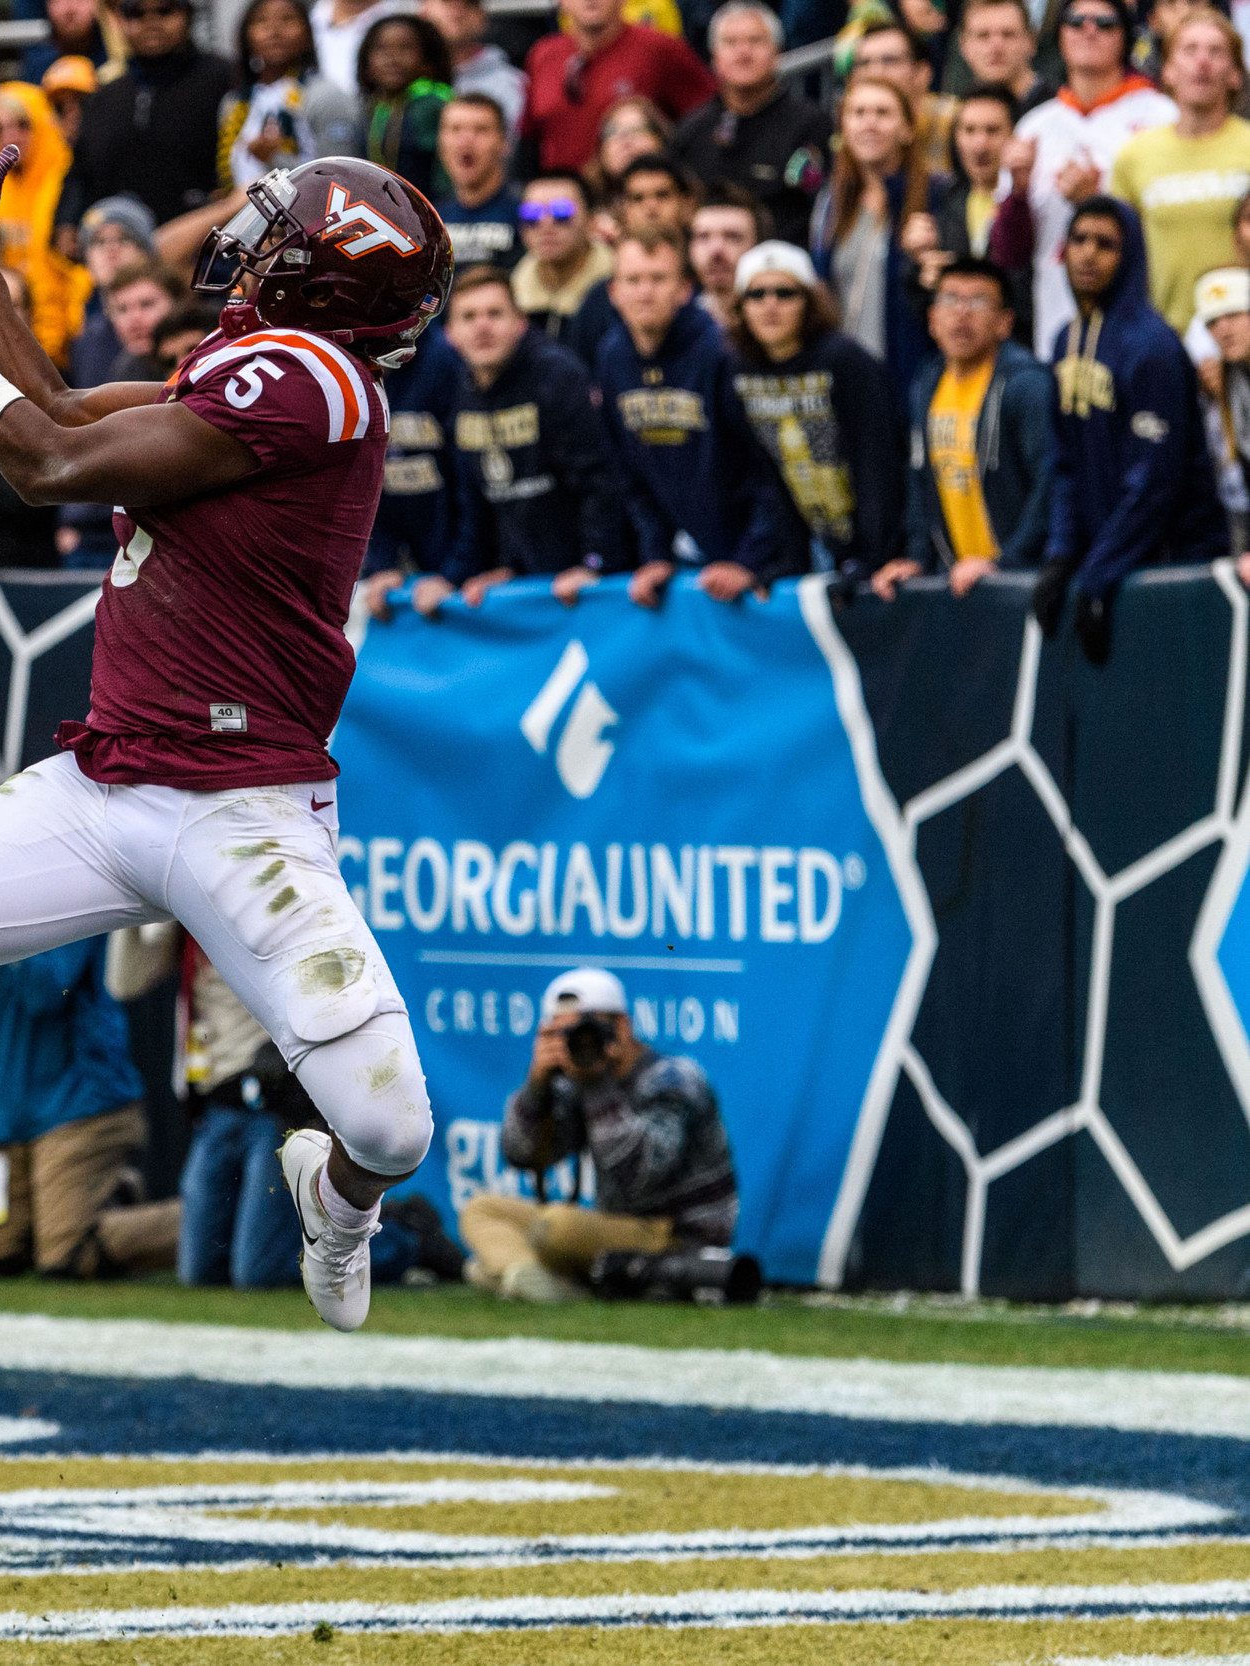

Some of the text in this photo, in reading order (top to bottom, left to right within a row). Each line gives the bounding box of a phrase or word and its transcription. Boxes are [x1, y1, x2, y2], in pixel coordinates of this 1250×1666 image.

[321, 181, 422, 261] VT
[224, 354, 286, 409] 5
[217, 708, 233, 716] 40
[426, 989, 739, 1043] CRED NION
